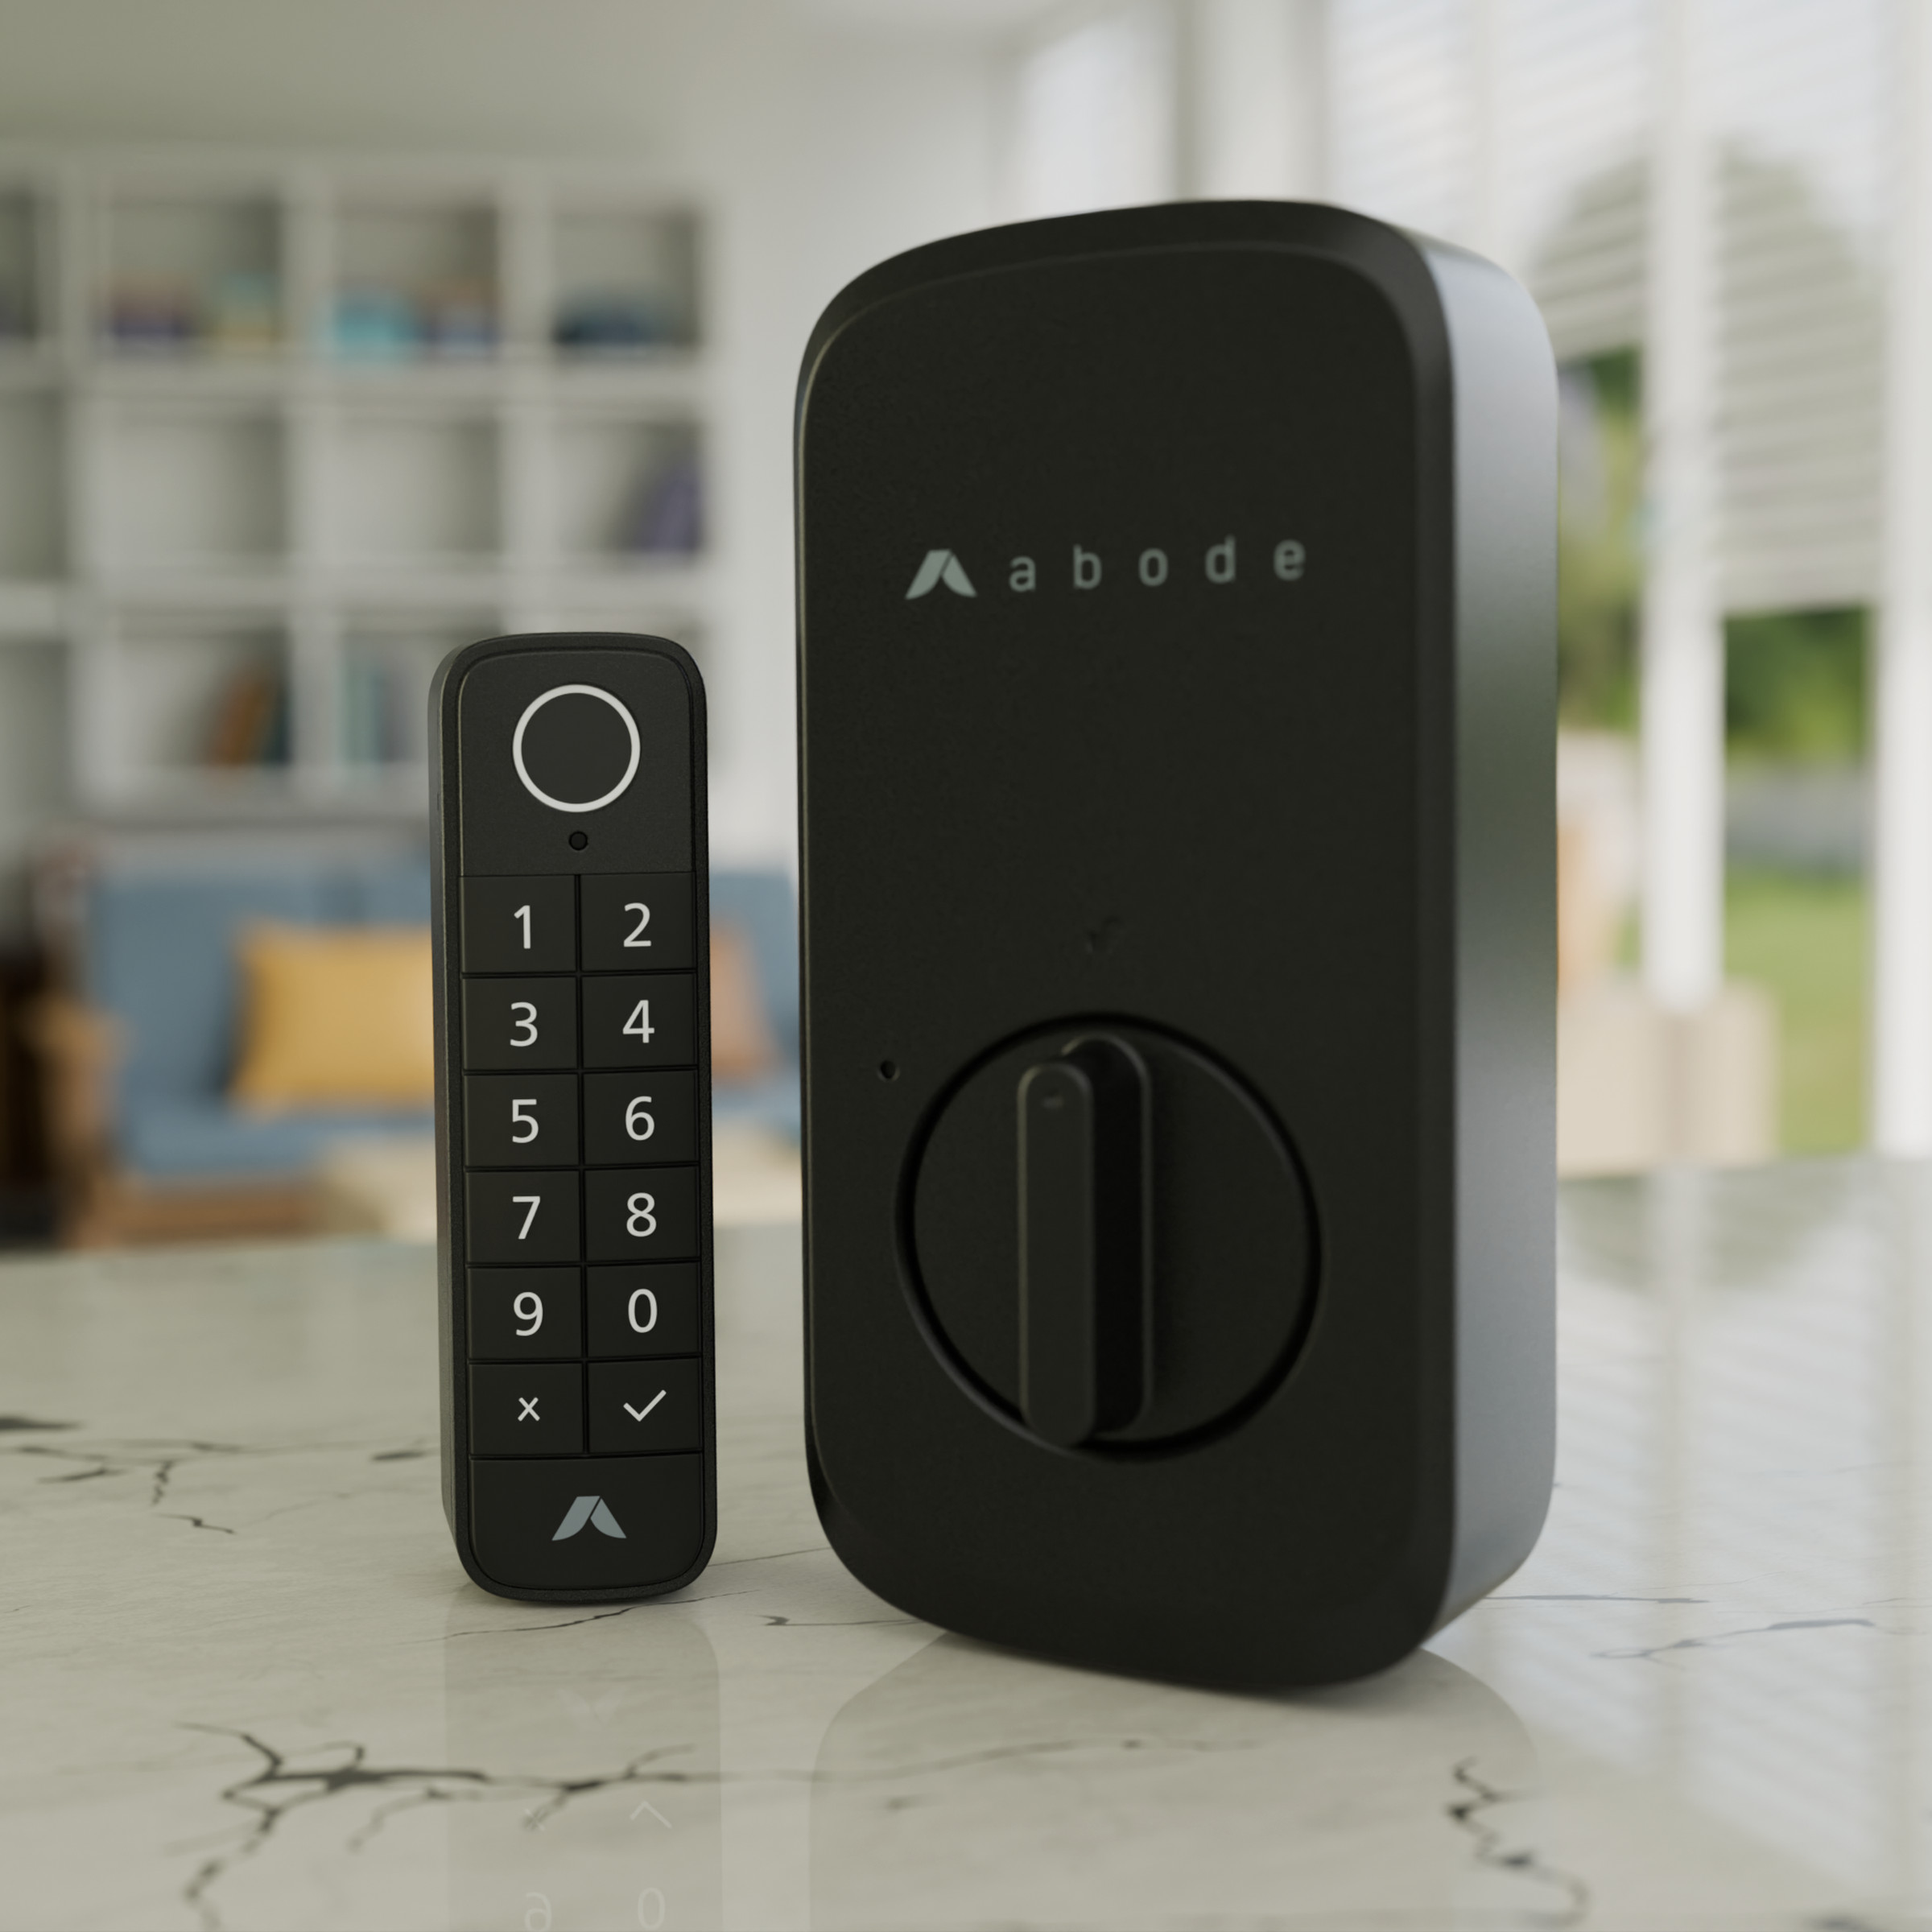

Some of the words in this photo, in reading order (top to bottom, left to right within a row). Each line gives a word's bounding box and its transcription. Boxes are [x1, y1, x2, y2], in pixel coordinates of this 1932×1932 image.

[1008, 534, 1306, 593] abode
[514, 905, 531, 950] 1
[623, 902, 652, 947] 2
[510, 1001, 539, 1047] 3
[622, 999, 655, 1044] 4
[512, 1098, 539, 1144] 5
[625, 1096, 655, 1141] 6
[512, 1195, 541, 1240] 7
[626, 1192, 657, 1237] 8
[513, 1291, 543, 1337] 9
[628, 1288, 658, 1334] 0
